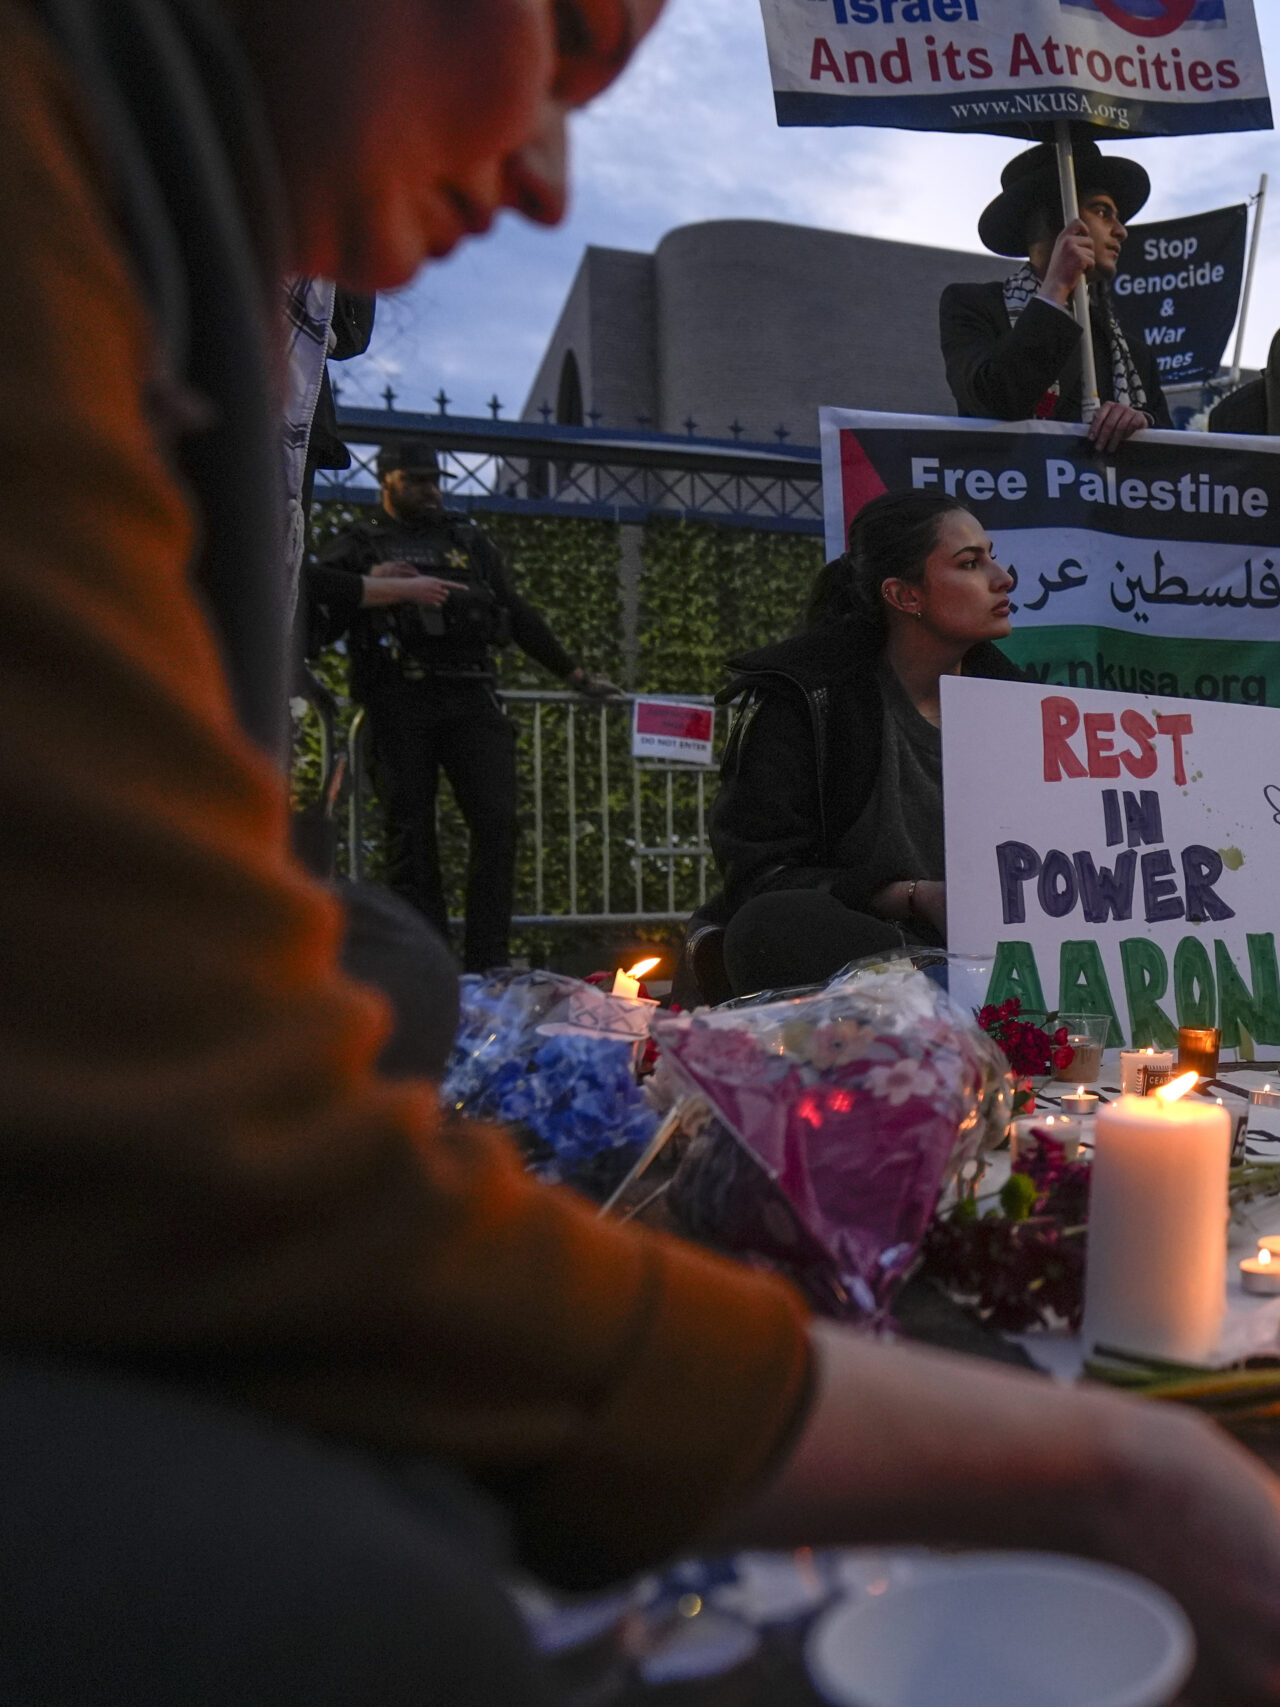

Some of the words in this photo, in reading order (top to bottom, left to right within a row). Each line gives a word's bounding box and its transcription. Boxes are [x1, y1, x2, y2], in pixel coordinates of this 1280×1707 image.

[810, 38, 912, 84] And
[927, 36, 994, 82] its
[1009, 32, 1241, 92] Atrocities
[950, 94, 1129, 129] www.NKUSA.org
[1143, 235, 1198, 262] Stop
[1114, 262, 1225, 297] Genocide
[1160, 298, 1175, 317] &
[1144, 326, 1186, 346] War
[911, 456, 1029, 500] Free
[1046, 458, 1270, 519] Palestine
[1040, 696, 1195, 787] REST
[1101, 789, 1165, 848] IN
[996, 841, 1236, 925] POWER
